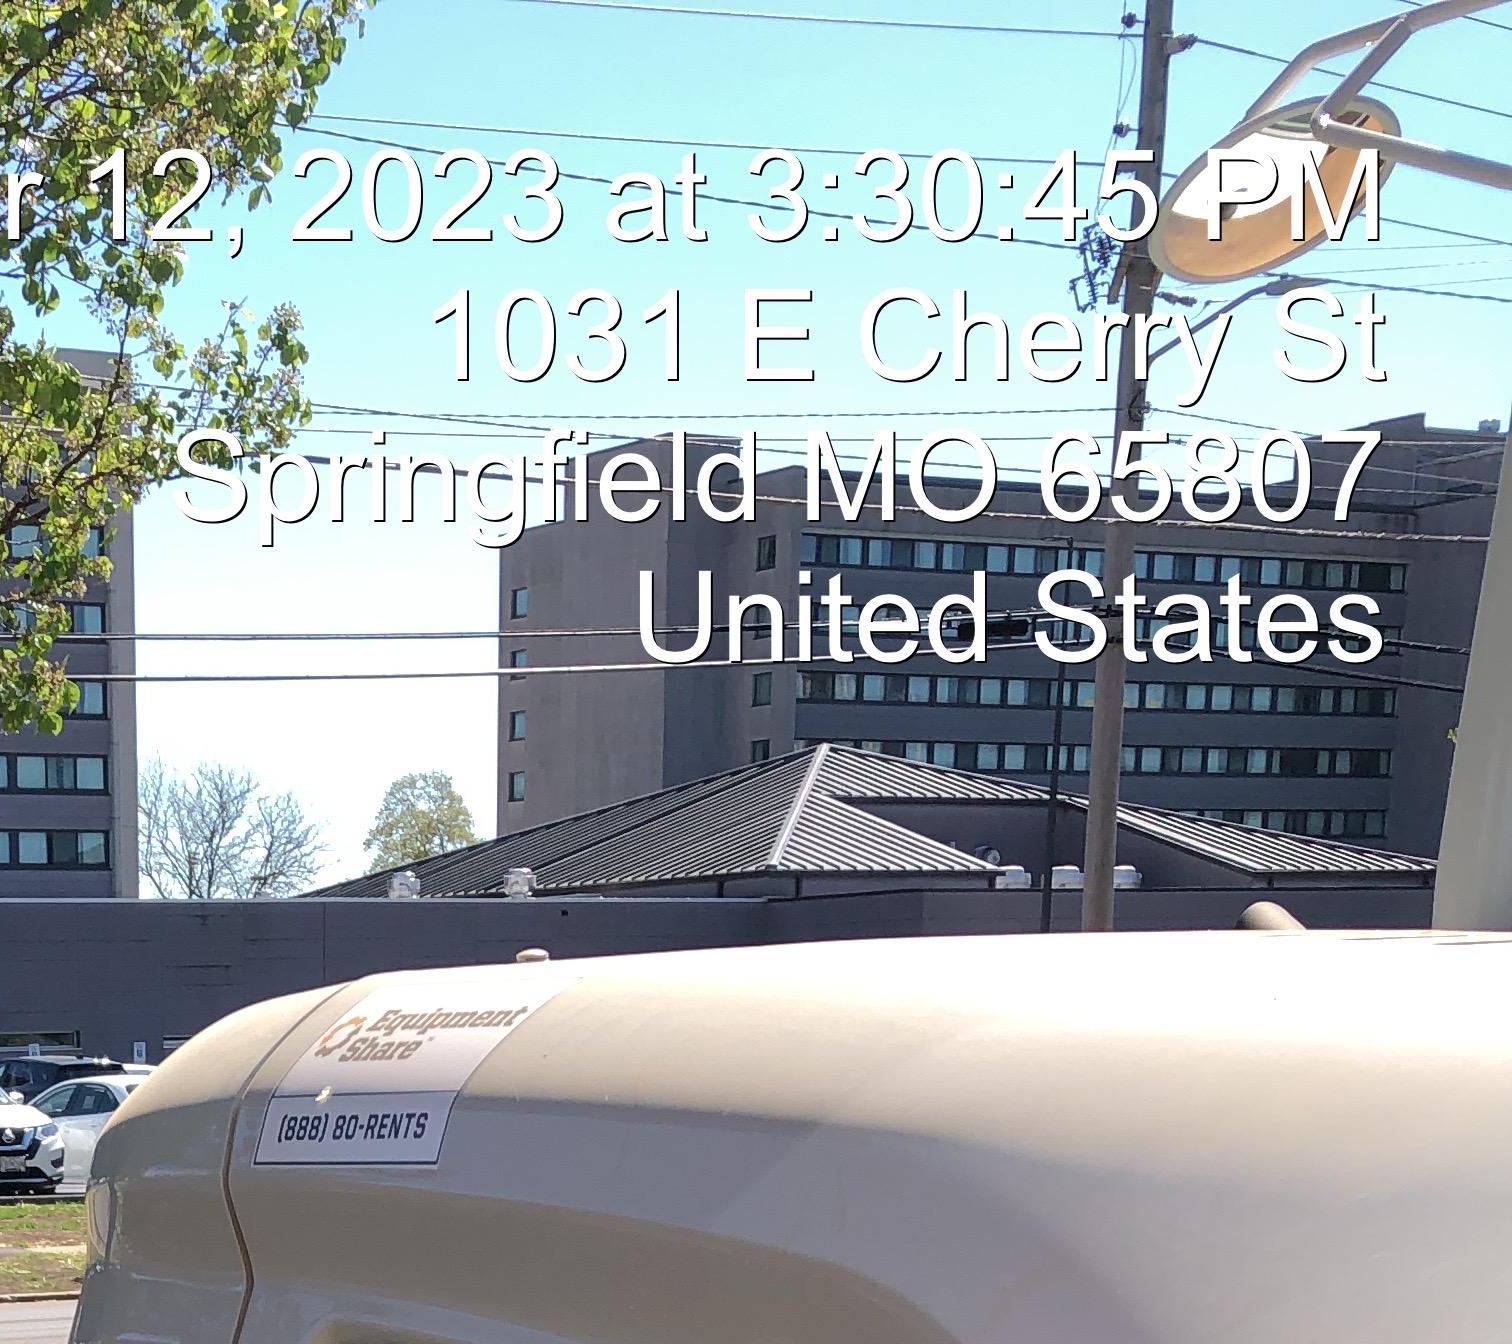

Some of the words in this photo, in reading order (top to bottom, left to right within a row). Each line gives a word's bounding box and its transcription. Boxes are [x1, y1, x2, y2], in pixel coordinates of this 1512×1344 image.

[366, 1006, 528, 1036] Equipment
[338, 1036, 424, 1063] Share
[277, 1112, 329, 1143] (888)
[332, 1112, 429, 1142] 80-RENTS
